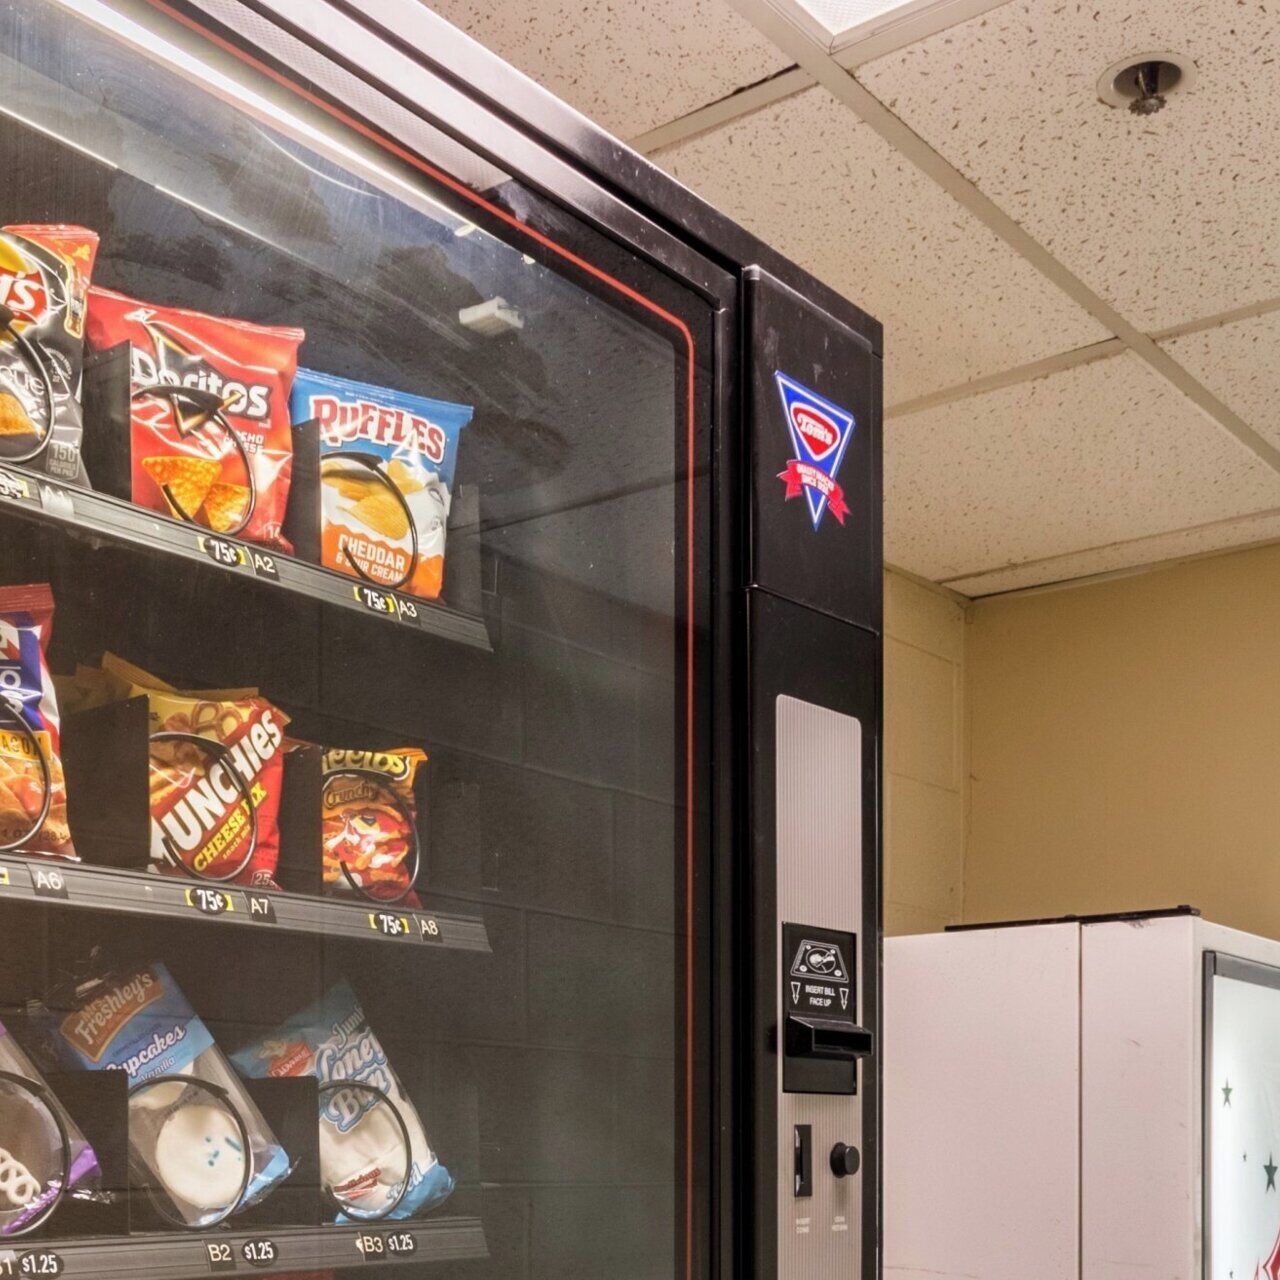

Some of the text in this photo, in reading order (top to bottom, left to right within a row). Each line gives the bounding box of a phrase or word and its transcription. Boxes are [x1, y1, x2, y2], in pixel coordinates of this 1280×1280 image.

[132, 347, 269, 417] Doritos
[312, 397, 444, 462] RUFFLES
[210, 539, 237, 561] 75¢
[339, 534, 405, 571] CHEDDAR
[255, 553, 276, 573] A2
[370, 566, 405, 583] CREAM
[363, 588, 387, 610] 75¢
[400, 601, 418, 618] A3
[193, 808, 246, 872] CHEESE
[37, 872, 62, 890] A6
[196, 889, 223, 910] 75¢
[251, 898, 269, 914] A7
[380, 915, 402, 935] 75¢
[421, 919, 439, 935] A8
[75, 973, 154, 1045] Freshley's
[208, 1242, 273, 1261] B2 $1.25
[364, 1233, 414, 1253] B3 $1.25
[22, 1254, 58, 1274] $1.25
